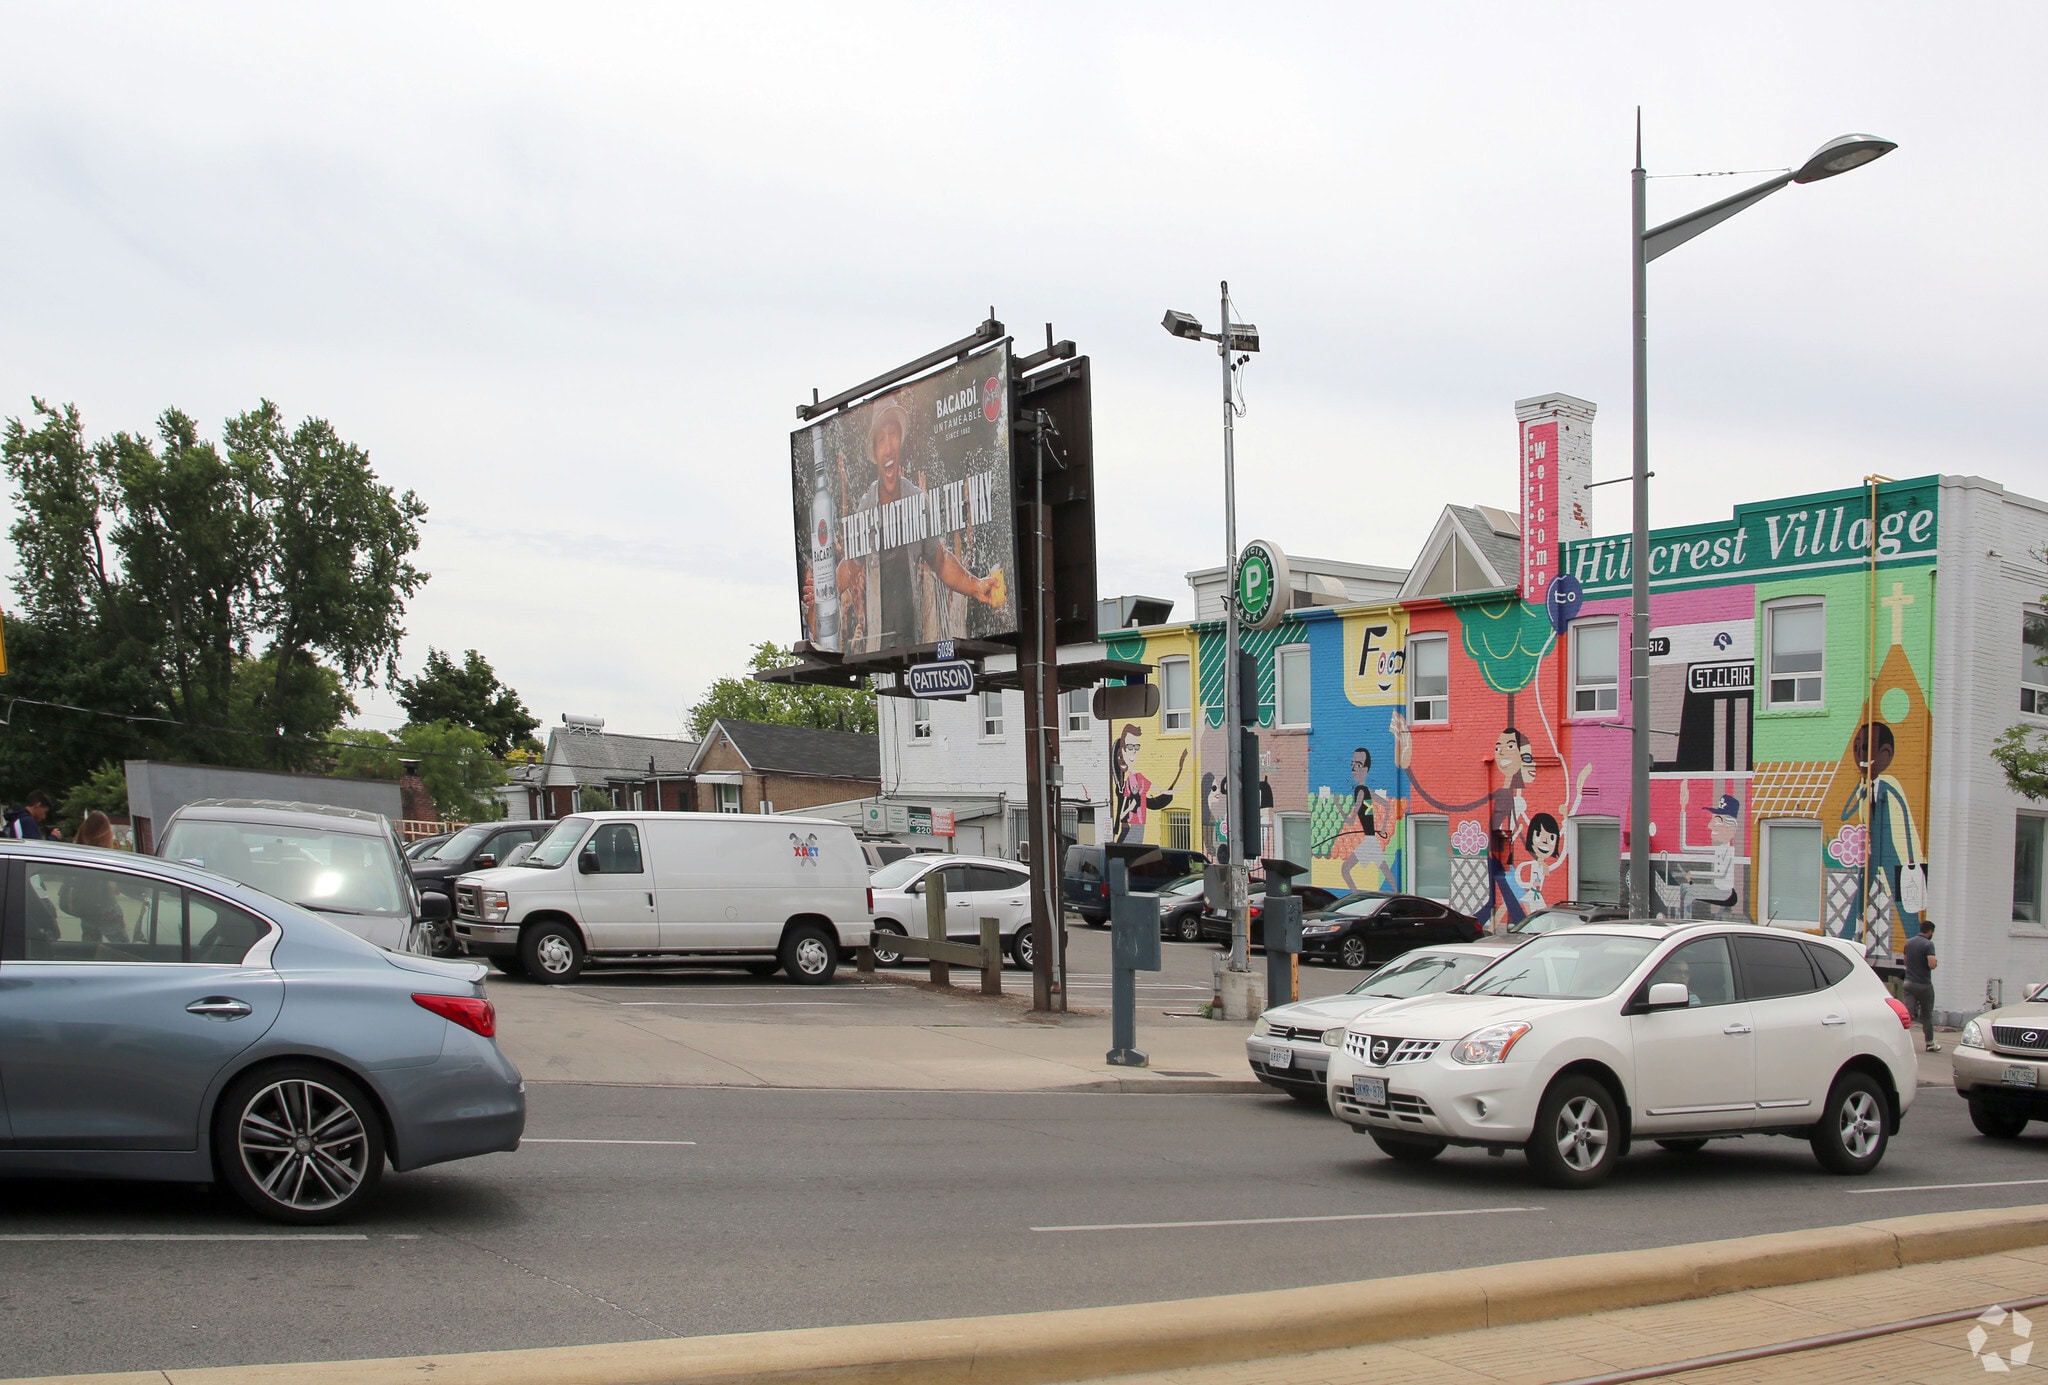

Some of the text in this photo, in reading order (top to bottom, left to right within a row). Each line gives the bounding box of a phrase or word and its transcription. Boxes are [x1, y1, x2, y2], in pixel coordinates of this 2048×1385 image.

[934, 408, 982, 434] UNTAMEABLE
[945, 431, 959, 441] SINCE
[841, 470, 992, 561] THERE'S NOTHING IN THE WAY
[1575, 506, 1933, 584] Hilcrest Village
[937, 641, 954, 659] 5039A
[913, 668, 968, 690] PATTISON
[916, 826, 930, 835] 220
